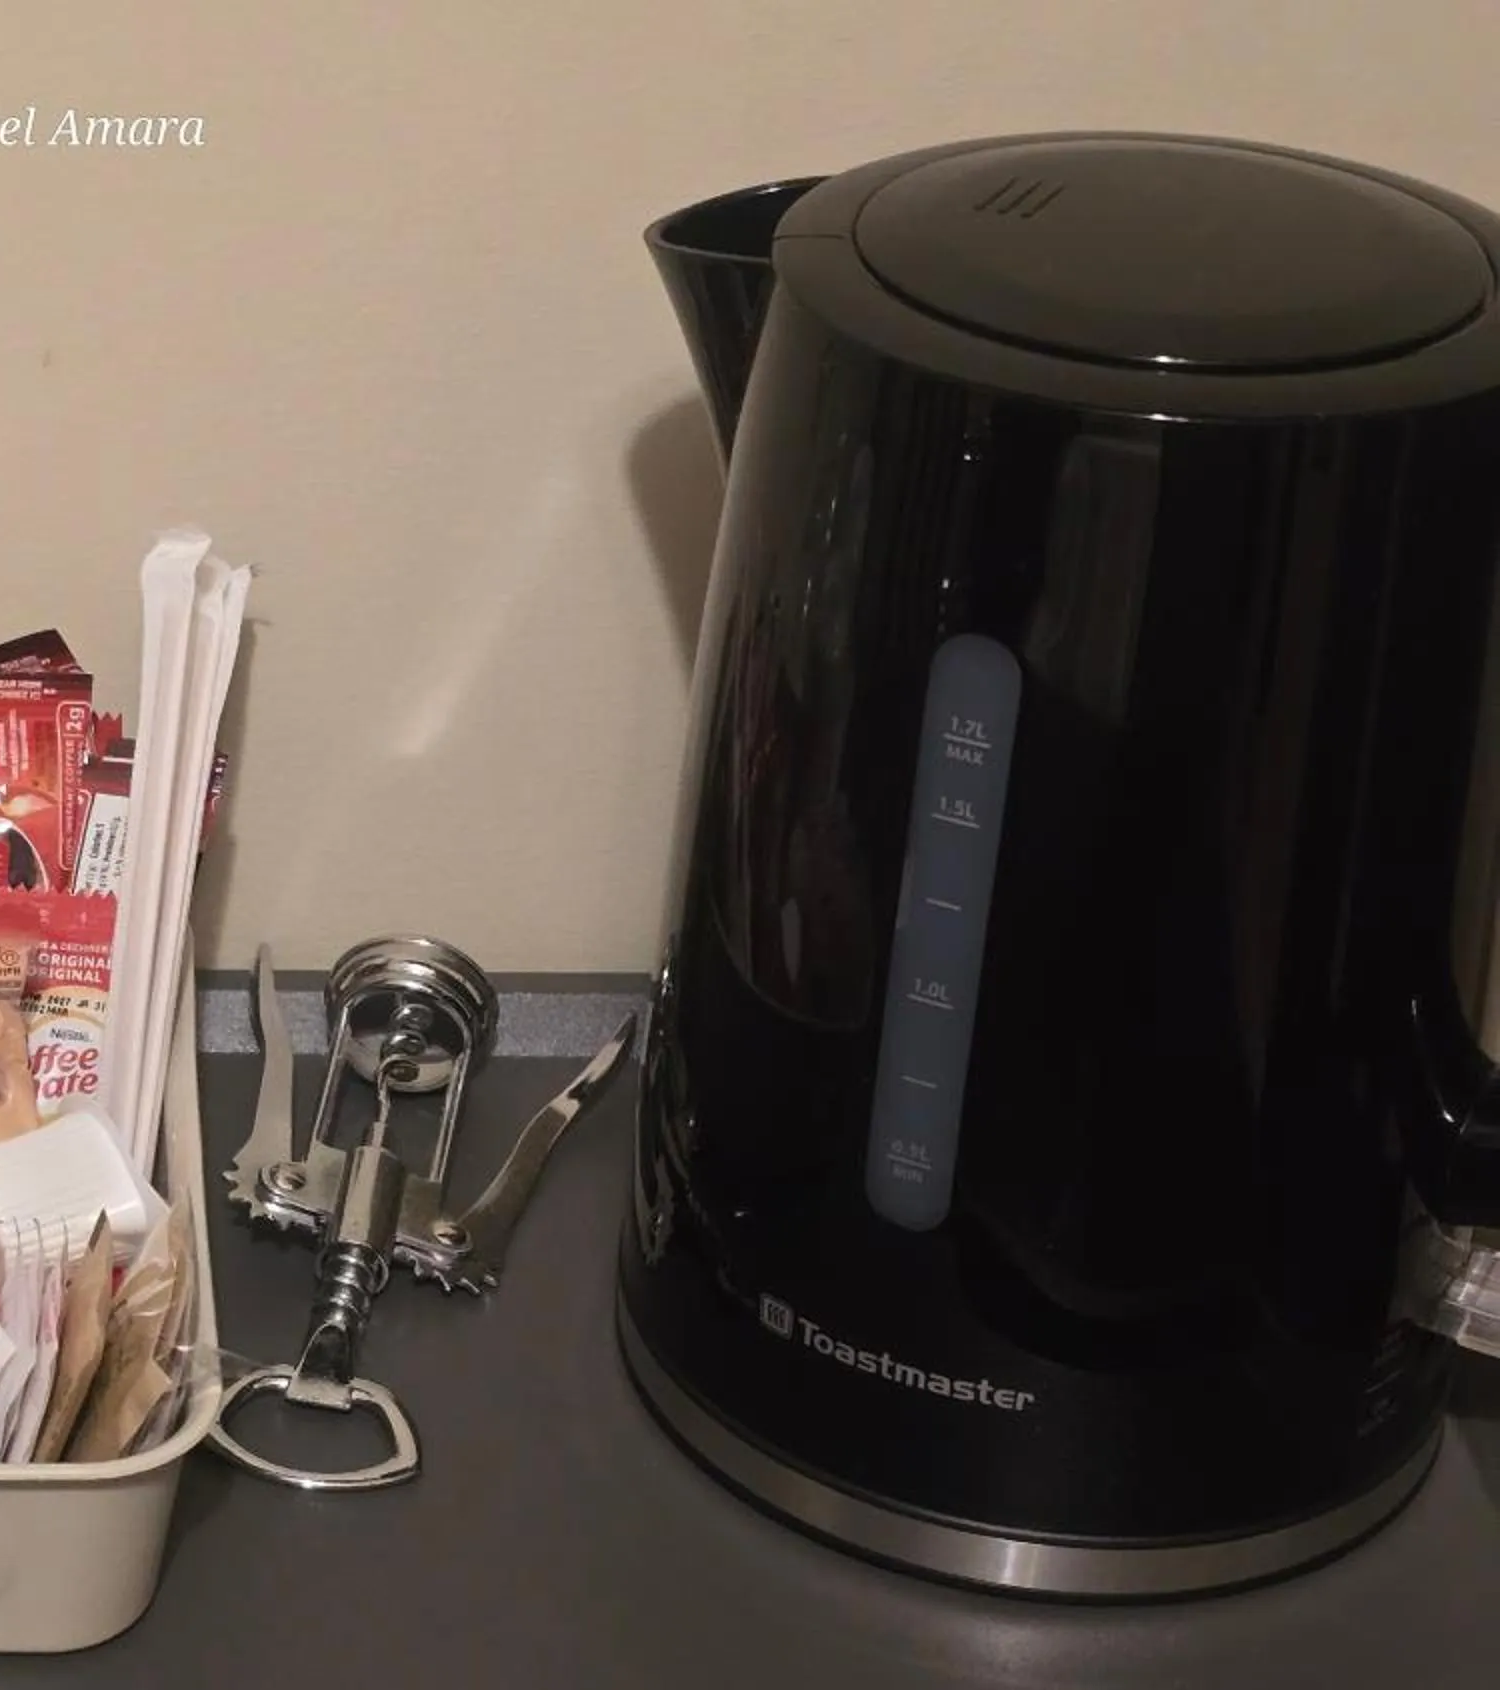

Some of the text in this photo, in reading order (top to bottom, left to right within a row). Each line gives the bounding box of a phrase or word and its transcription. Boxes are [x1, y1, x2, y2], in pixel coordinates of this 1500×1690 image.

[66, 707, 85, 731] 2g
[950, 715, 987, 740] 1.7L
[945, 743, 985, 766] MAX
[939, 795, 976, 820] 1.5L
[30, 1043, 99, 1075] ffee
[38, 1070, 99, 1099] ate
[798, 1316, 1036, 1412] Toastmaster
